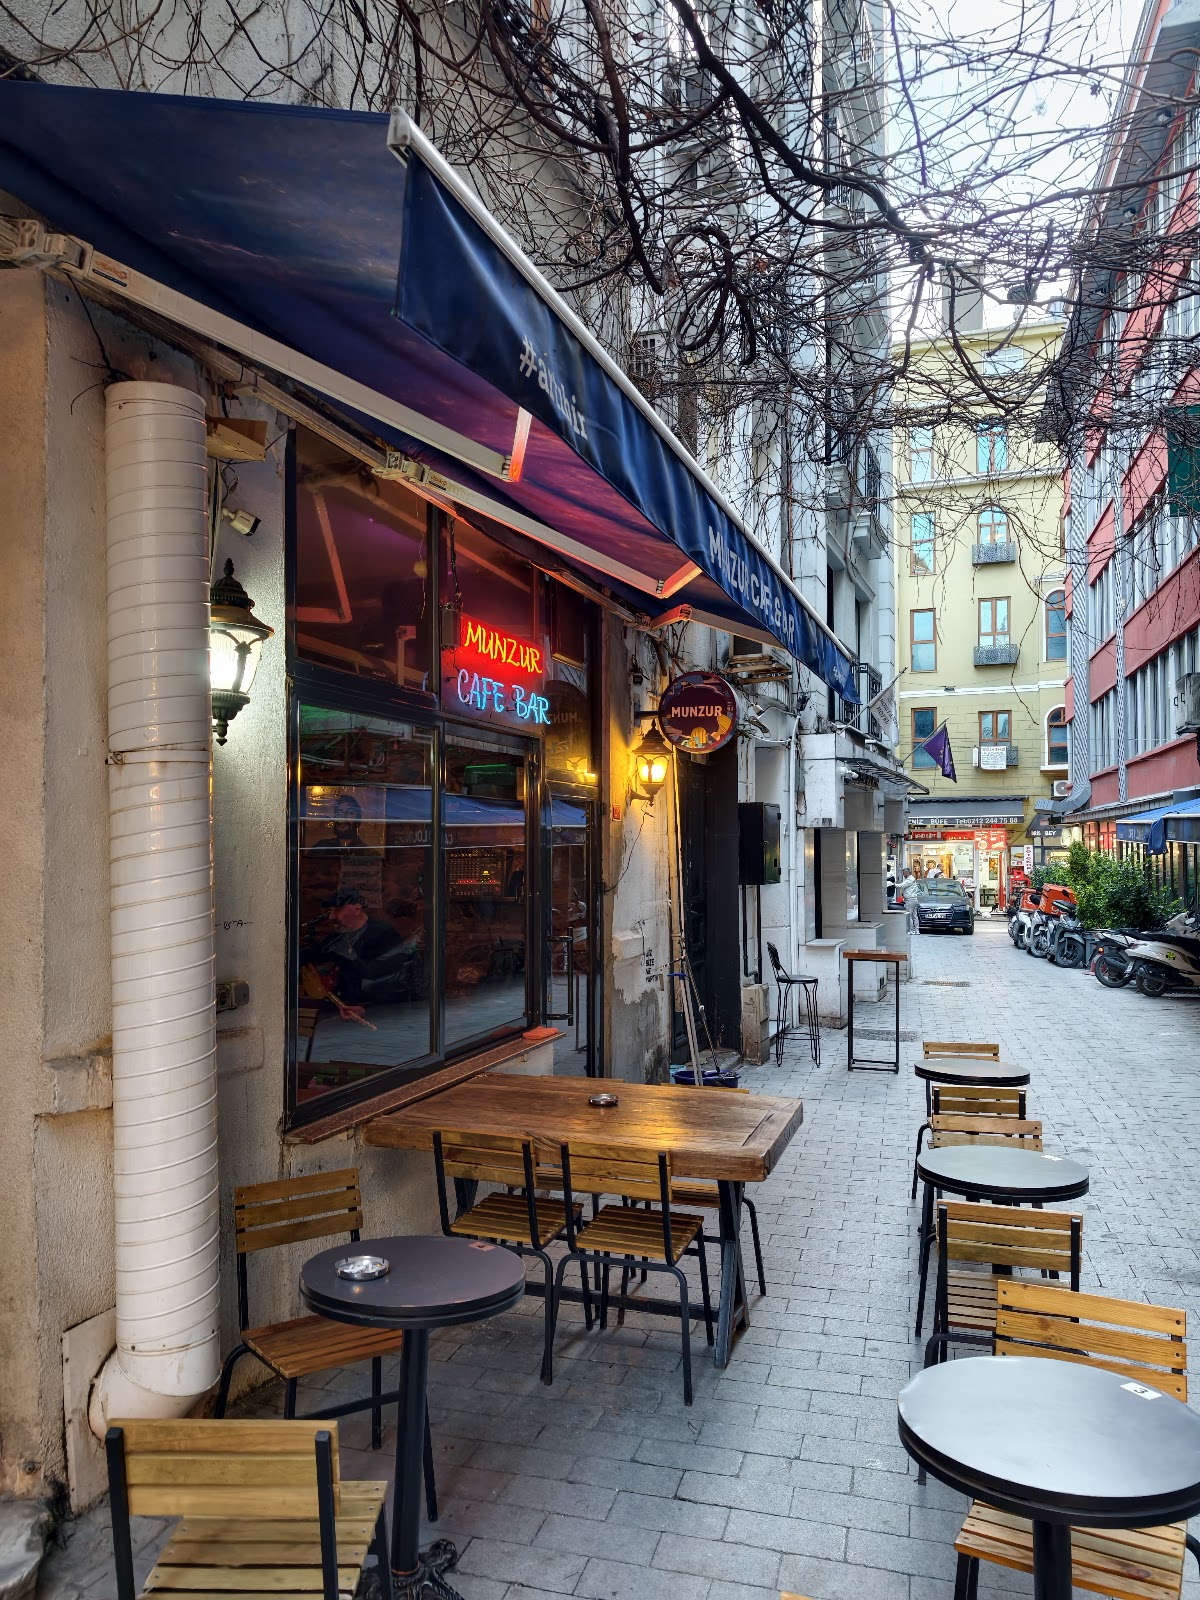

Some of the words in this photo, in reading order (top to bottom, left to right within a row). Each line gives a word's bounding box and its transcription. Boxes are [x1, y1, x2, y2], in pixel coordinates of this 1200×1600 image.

[464, 621, 543, 674] MUNZUR
[457, 668, 504, 713] CAFE
[511, 684, 551, 725] BAR
[671, 705, 723, 718] MUNZUR
[930, 817, 948, 825] BÜFE
